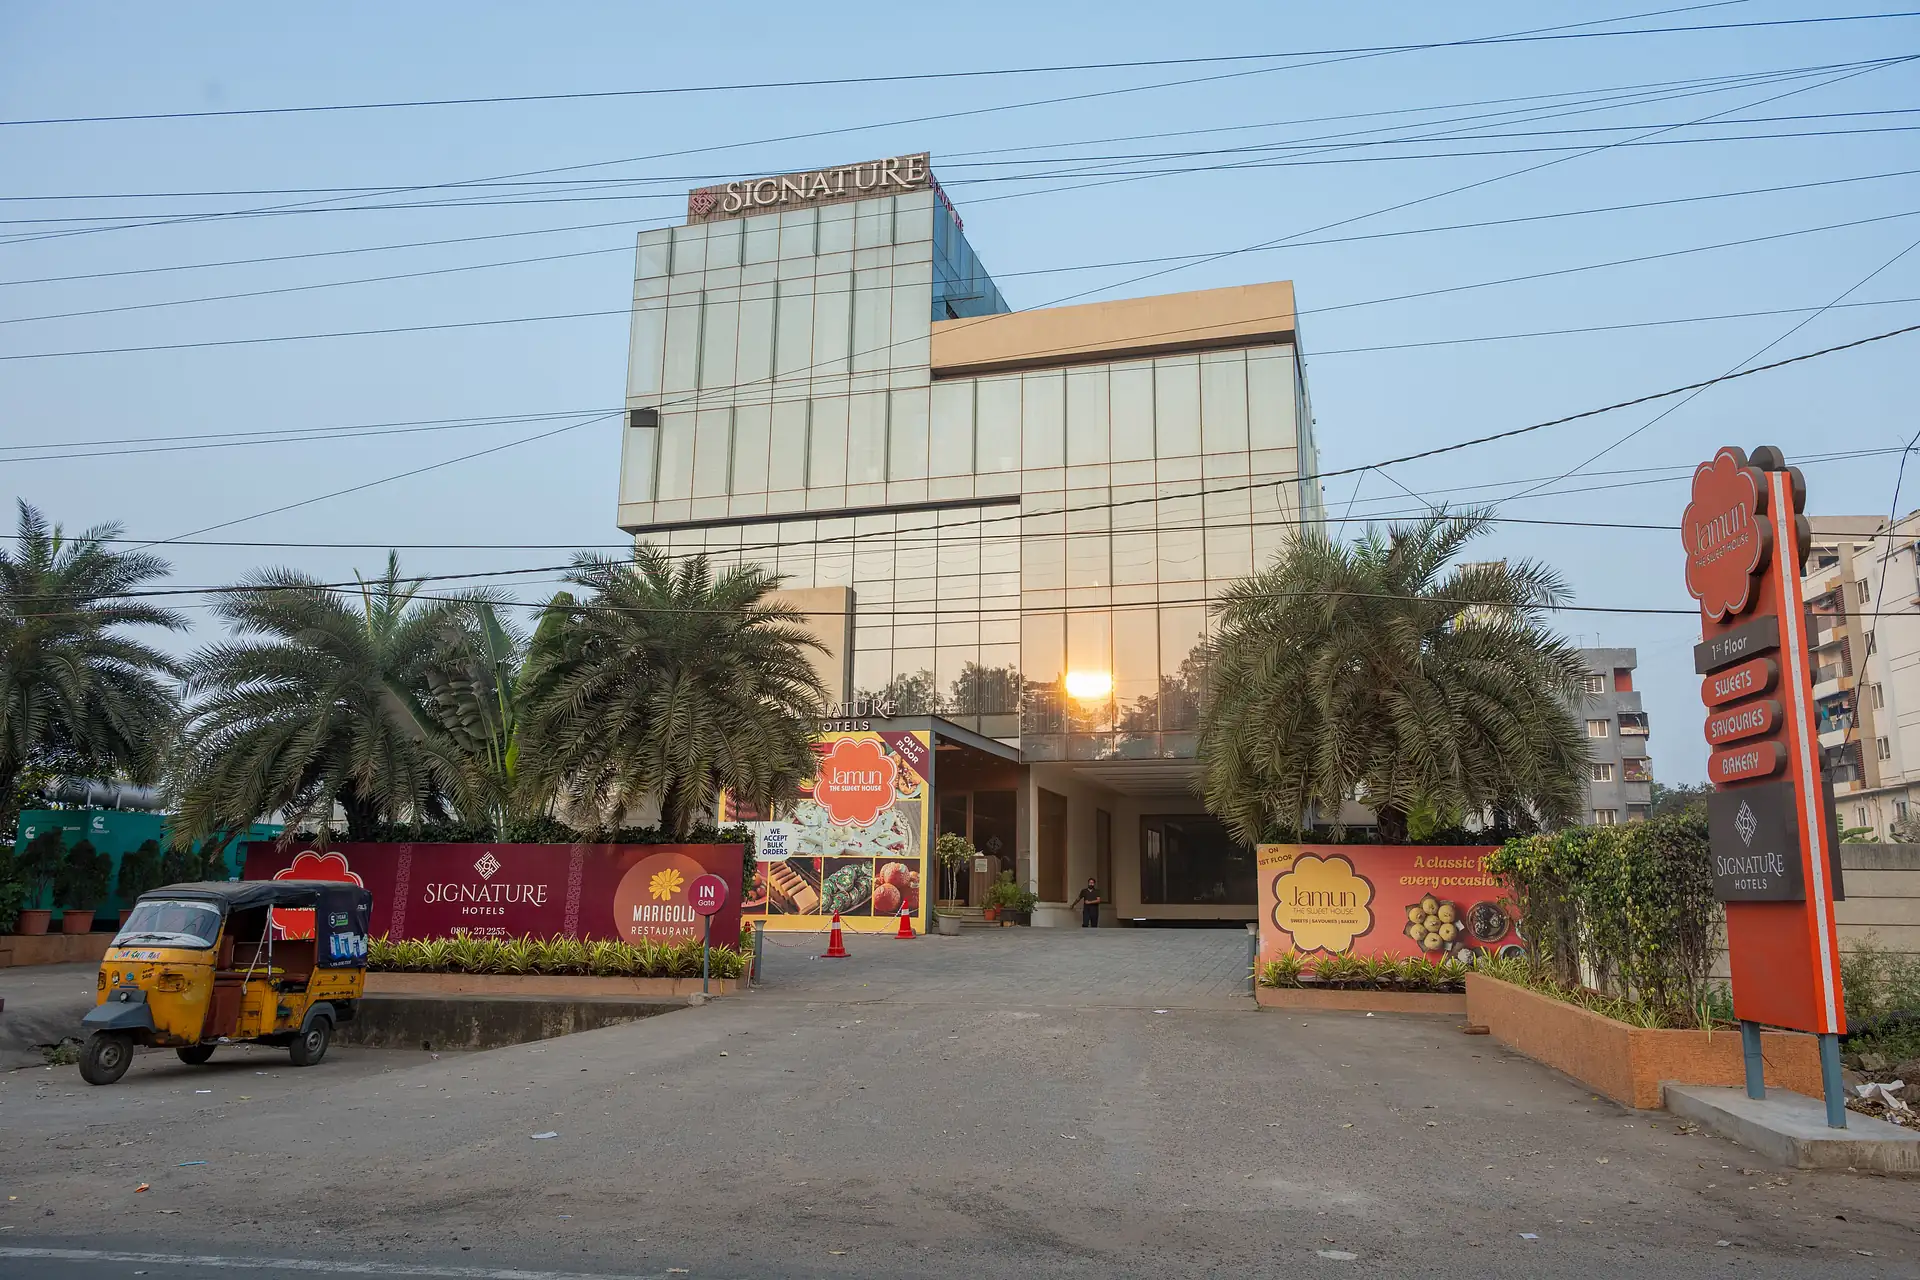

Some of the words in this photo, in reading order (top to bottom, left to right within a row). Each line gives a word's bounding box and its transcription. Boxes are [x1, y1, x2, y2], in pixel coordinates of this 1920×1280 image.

[723, 154, 927, 214] SIGNATURE
[1694, 502, 1747, 555] Jamun
[1695, 560, 1706, 568] THE
[1707, 545, 1725, 564] SWEET
[1727, 532, 1749, 552] HOUSE
[1724, 636, 1748, 656] Floor
[1715, 669, 1752, 698] SWEETS
[1711, 708, 1764, 738] SAVOURIES
[903, 736, 915, 748] ON
[896, 740, 919, 764] FLOOR
[1722, 751, 1759, 775] BAKERY
[828, 767, 882, 785] Jamun
[764, 834, 788, 842] ACCEPT
[762, 848, 788, 856] ORDERS
[1258, 858, 1270, 866] 1ST
[1270, 854, 1293, 864] FLOOR
[1414, 856, 1425, 868] A
[1426, 856, 1475, 869] classic
[1717, 852, 1785, 877] SIGNATURE
[1400, 876, 1440, 889] every
[1734, 878, 1768, 890] HOTELS
[424, 883, 548, 907] SIGNATURE
[700, 886, 714, 898] IN
[1288, 886, 1356, 907] Jamun
[462, 907, 505, 915] HOTELS
[632, 904, 696, 922] MARIGOLD
[486, 927, 506, 936] 2255
[631, 926, 695, 936] RESTAURANT
